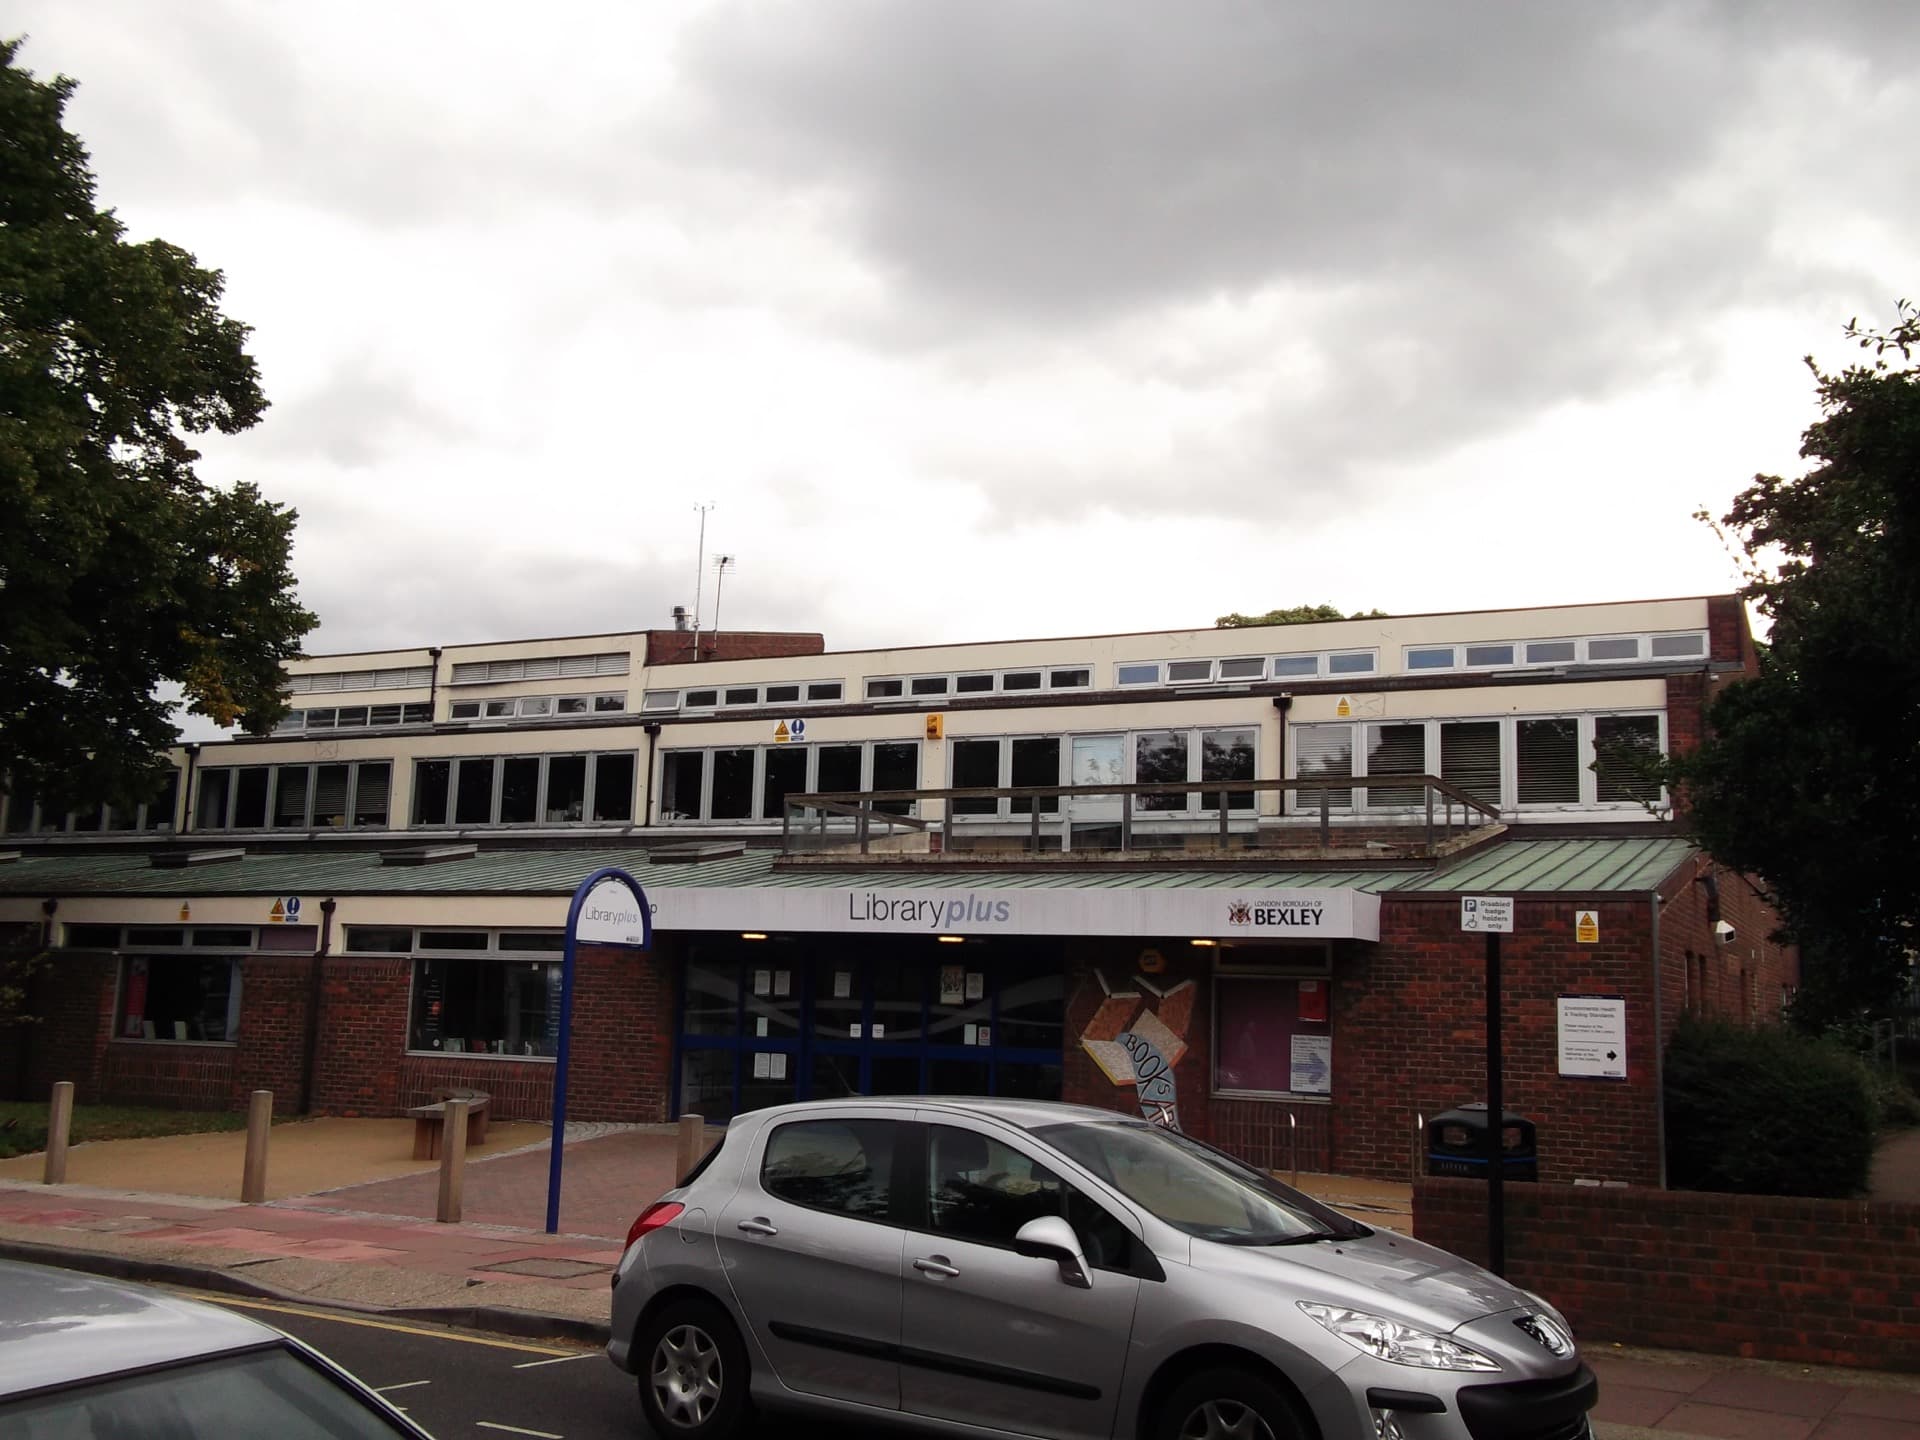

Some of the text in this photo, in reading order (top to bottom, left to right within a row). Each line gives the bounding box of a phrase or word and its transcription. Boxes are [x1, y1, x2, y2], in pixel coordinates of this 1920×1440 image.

[1254, 900, 1322, 908] LONDON BOROUGH OF
[1254, 908, 1323, 926] BEXLEY
[1124, 1034, 1175, 1102] BOOKS
